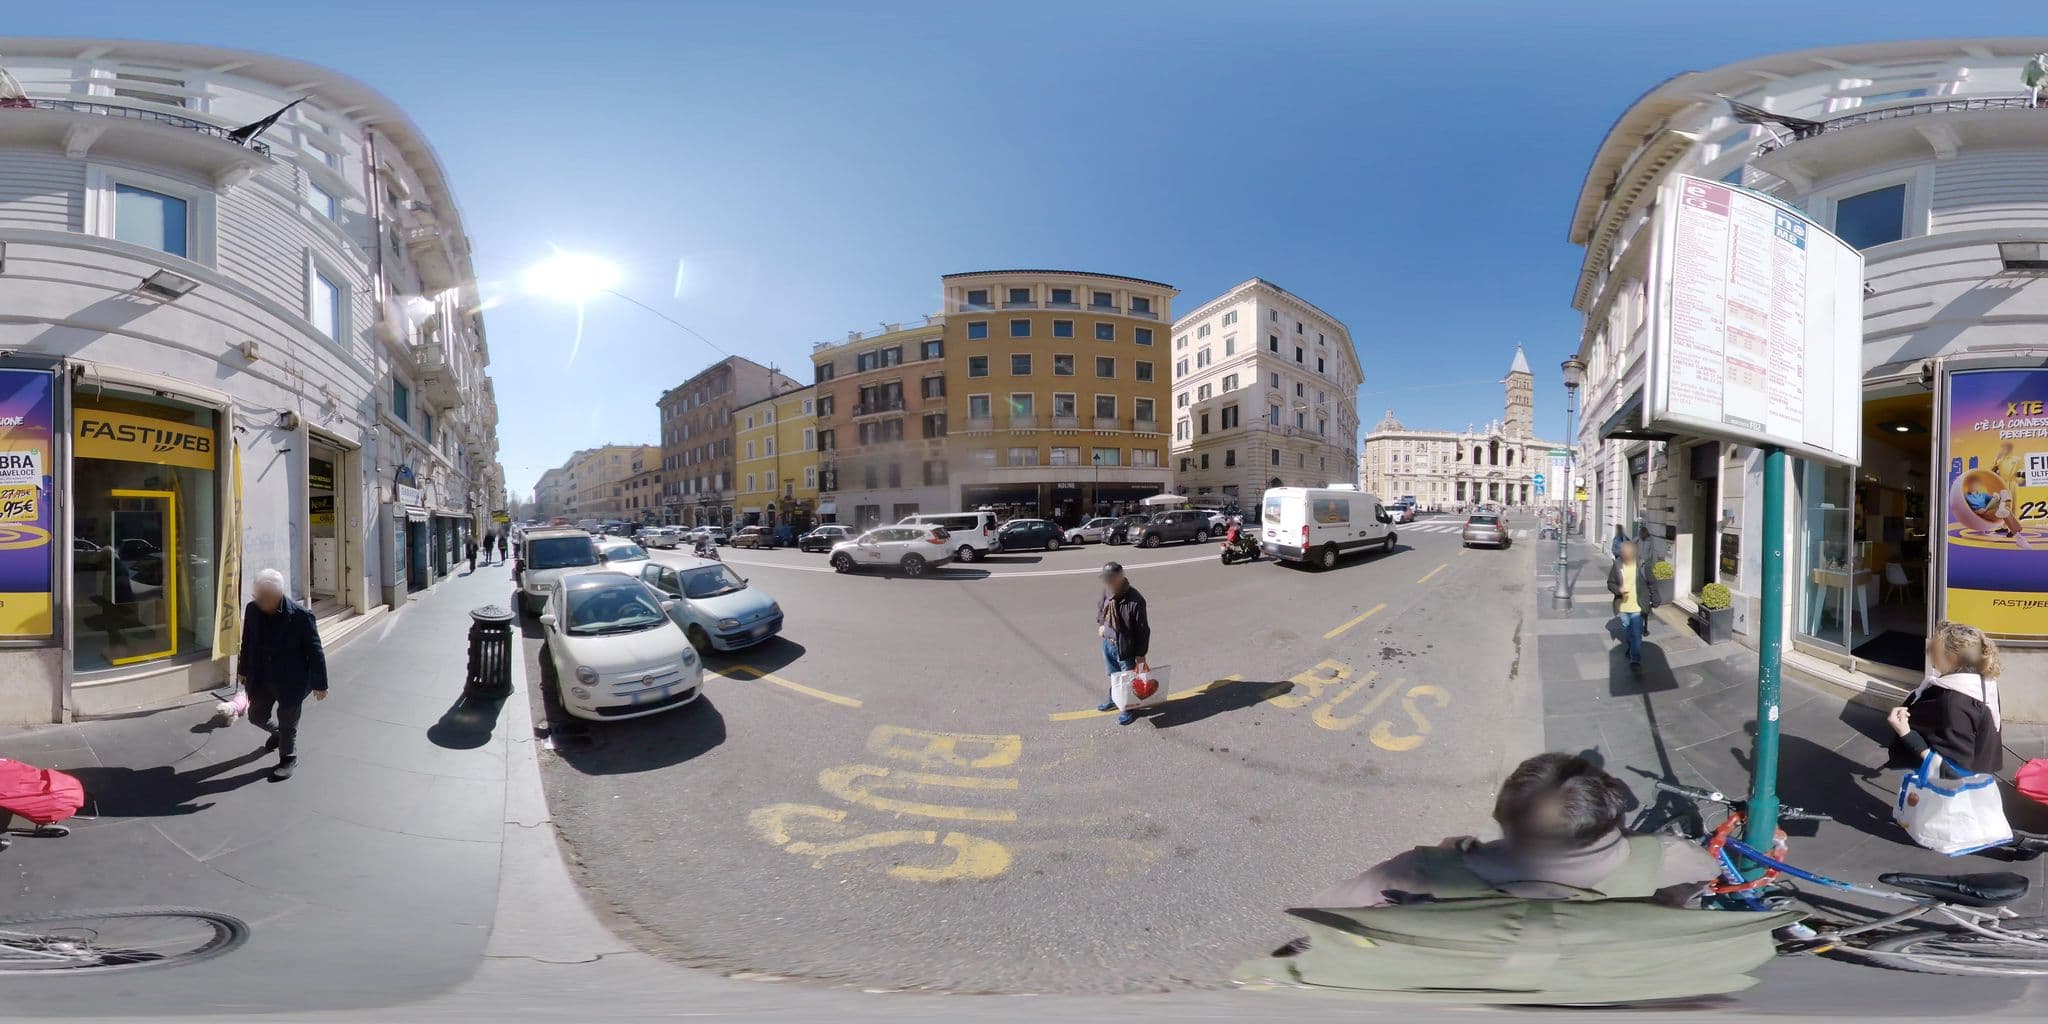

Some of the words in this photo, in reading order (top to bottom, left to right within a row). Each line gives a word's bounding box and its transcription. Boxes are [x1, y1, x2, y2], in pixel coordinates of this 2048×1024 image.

[1992, 418, 2005, 430] LA
[2006, 401, 2018, 417] X
[2022, 400, 2044, 416] TE
[80, 420, 210, 453] FASTWEB
[1263, 658, 1451, 751] BUS
[747, 724, 1022, 882] BUS
